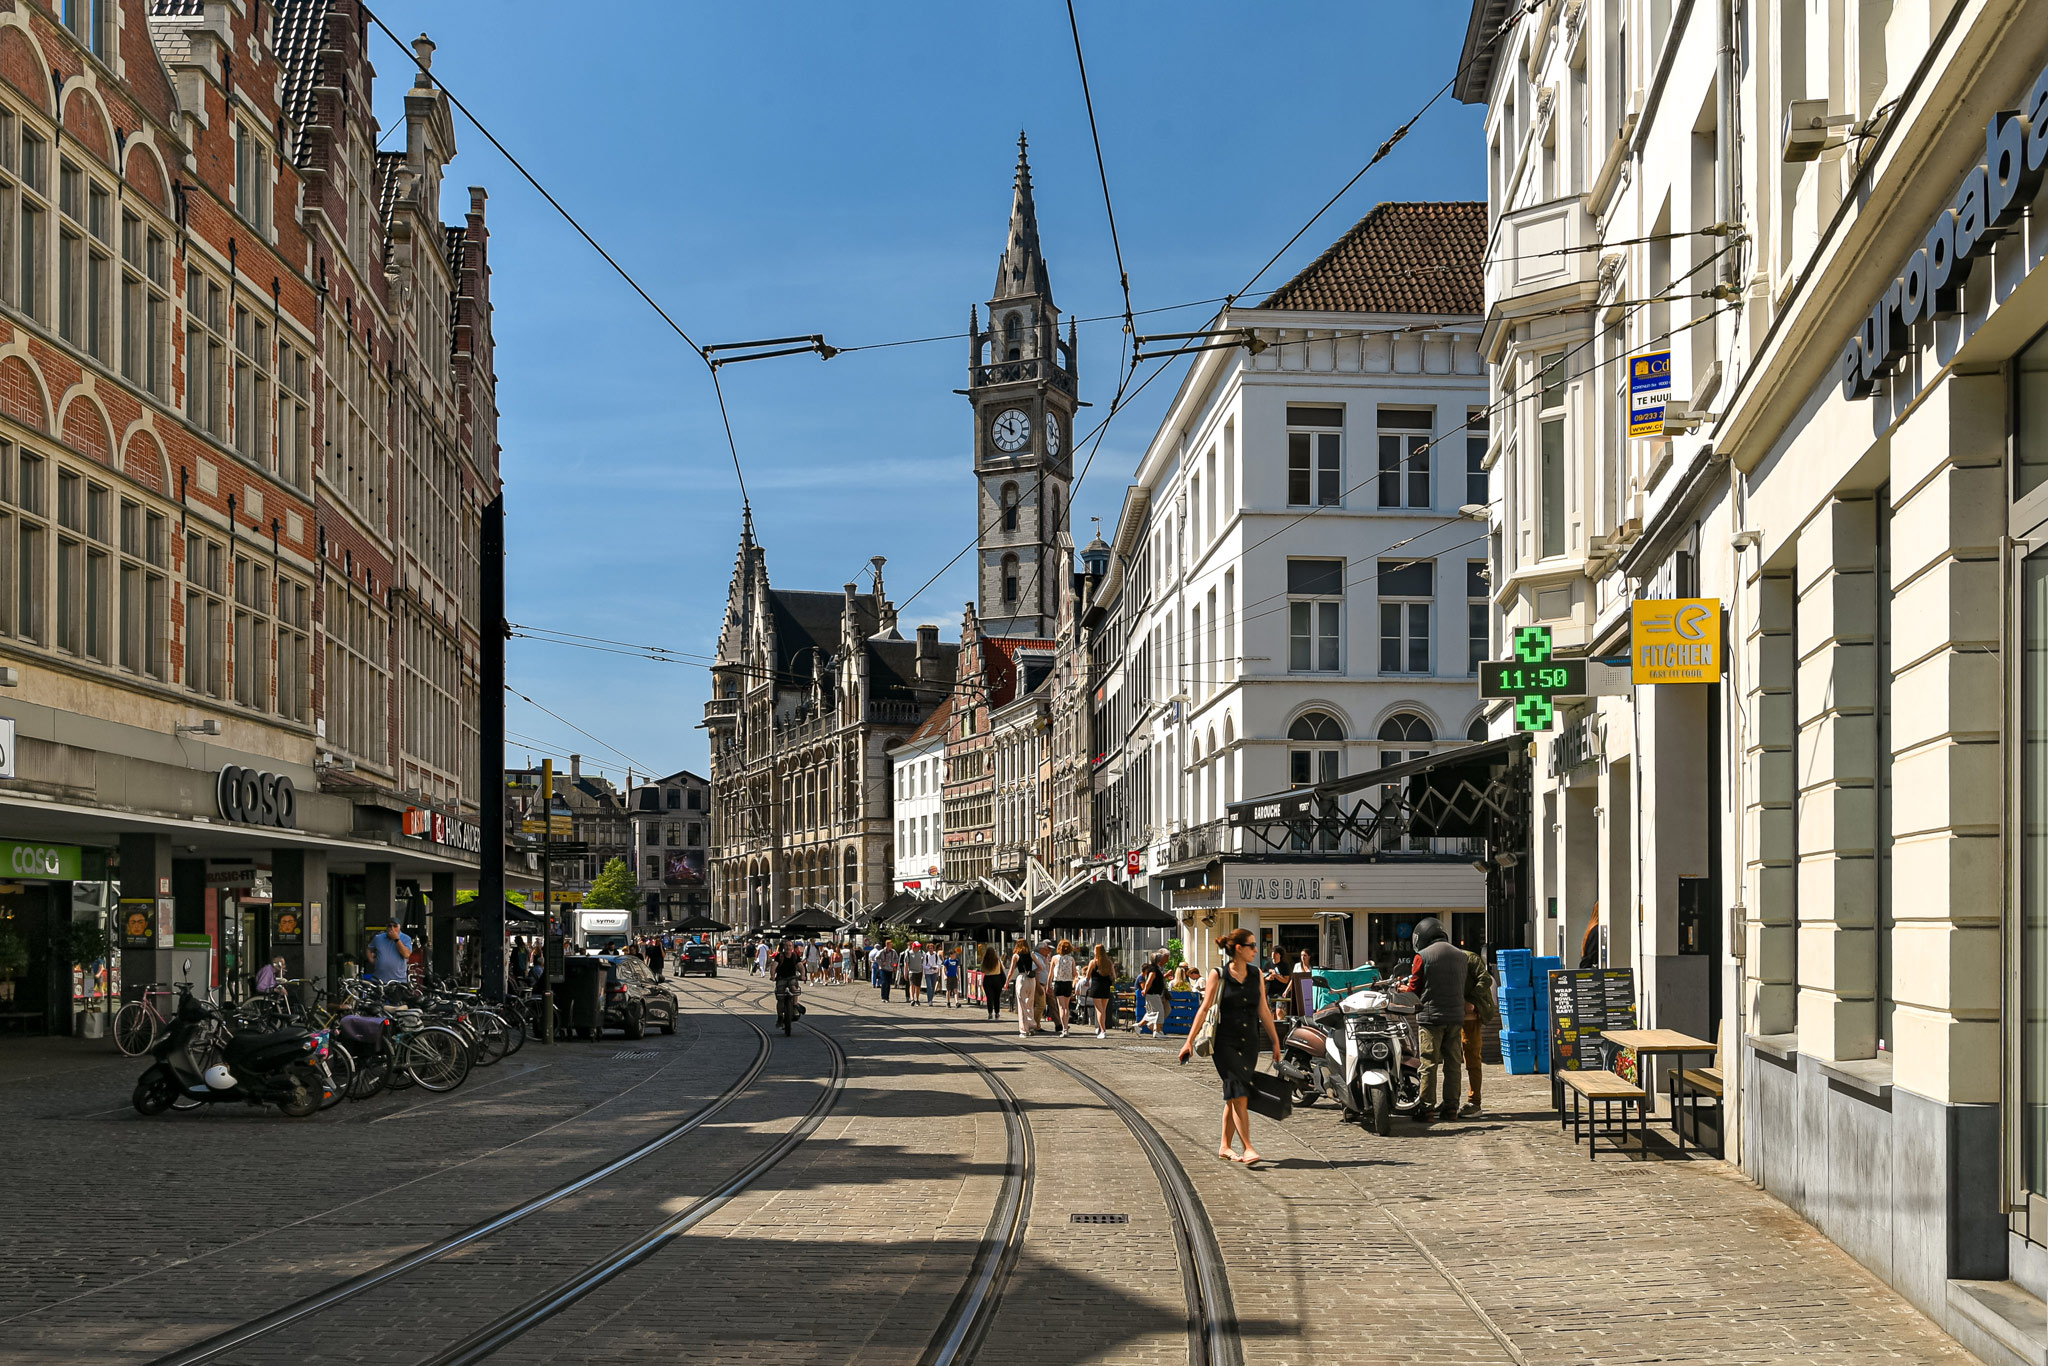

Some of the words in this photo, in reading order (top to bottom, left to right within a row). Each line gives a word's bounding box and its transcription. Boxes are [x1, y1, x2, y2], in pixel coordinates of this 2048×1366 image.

[1637, 397, 1648, 406] TE
[1641, 643, 1712, 667] FITCHEN
[1500, 668, 1566, 690] 11:50
[219, 764, 296, 829] casa
[1254, 804, 1281, 820] BAROUCHE
[446, 816, 462, 848] HANS
[12, 846, 60, 874] casa
[1129, 853, 1138, 866] Q
[1238, 878, 1320, 900] WASBAR
